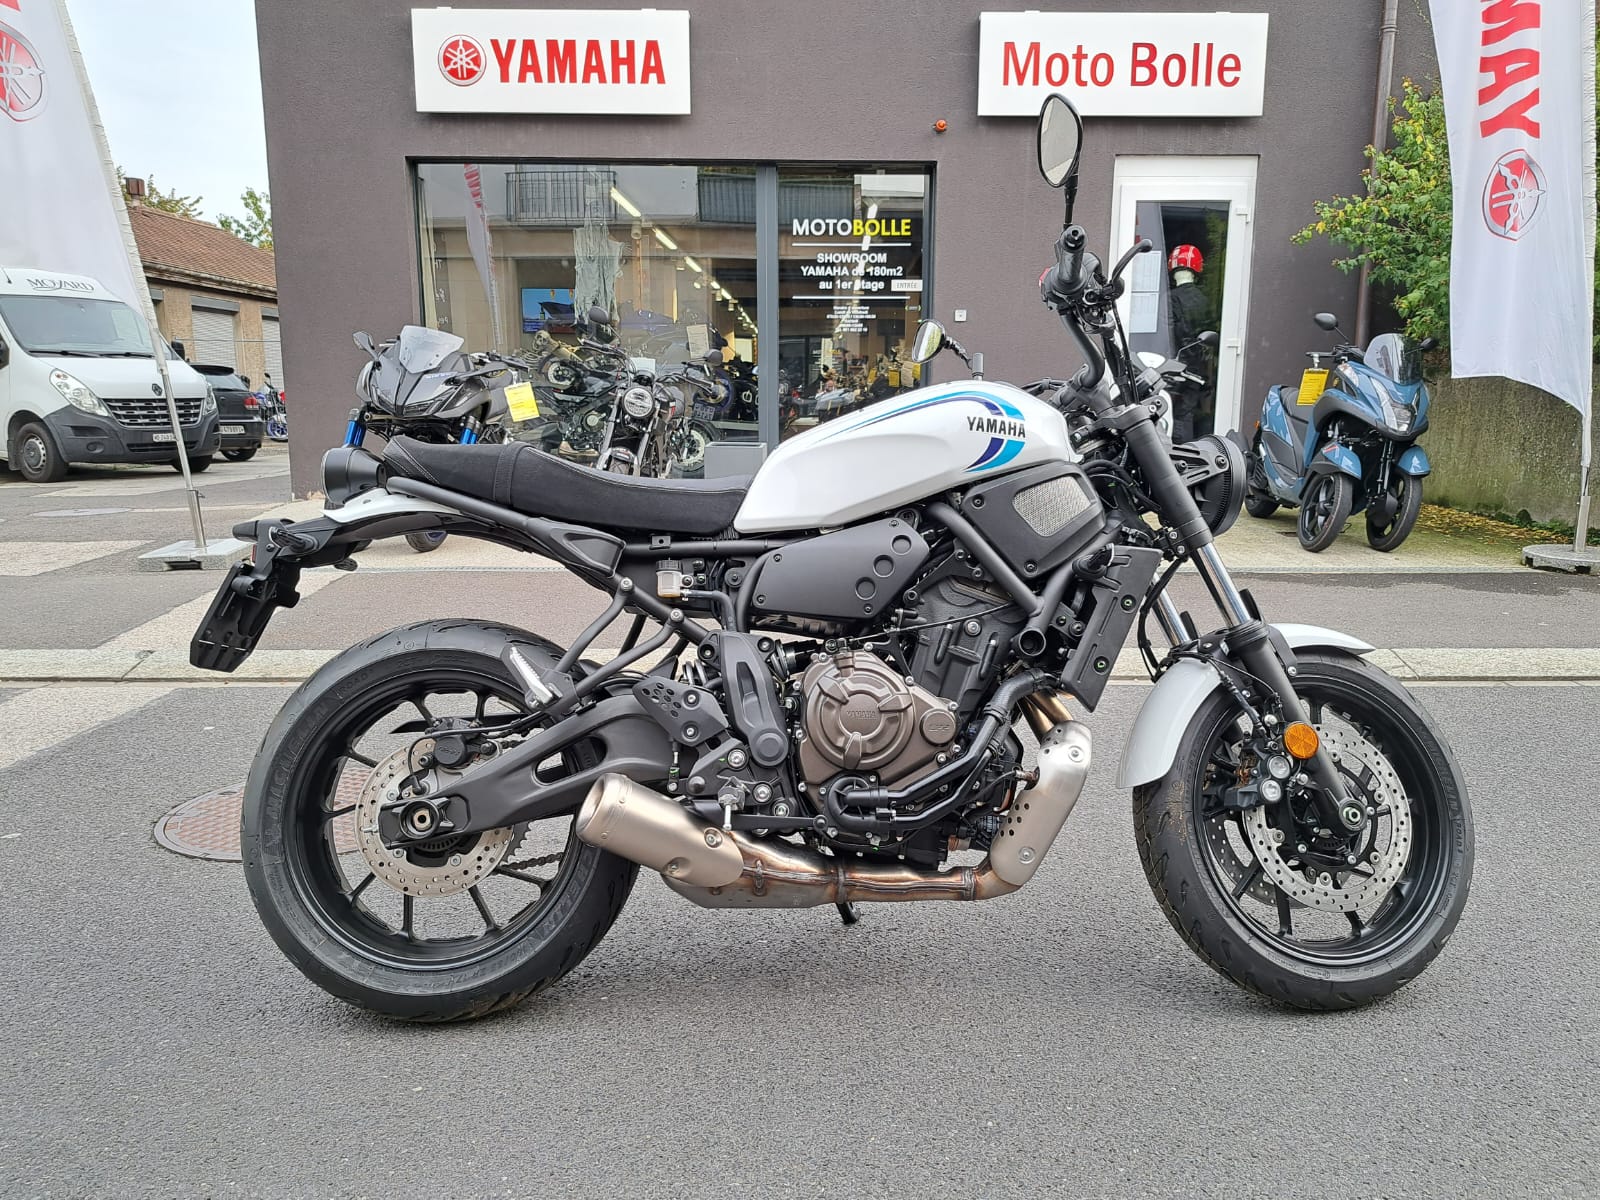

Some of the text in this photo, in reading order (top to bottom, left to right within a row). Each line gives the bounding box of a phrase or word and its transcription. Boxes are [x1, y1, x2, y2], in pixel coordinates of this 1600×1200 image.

[489, 38, 666, 84] YAMAHA
[1002, 41, 1241, 87] Moto Bolle
[792, 218, 912, 236] MOTOBOLLE
[816, 253, 888, 263] SHOWROOM
[800, 266, 850, 276] YAMAHA
[868, 266, 903, 276] 180m2
[818, 280, 833, 289] au
[835, 279, 853, 289] 1er
[966, 416, 1026, 438] YAMAHA
